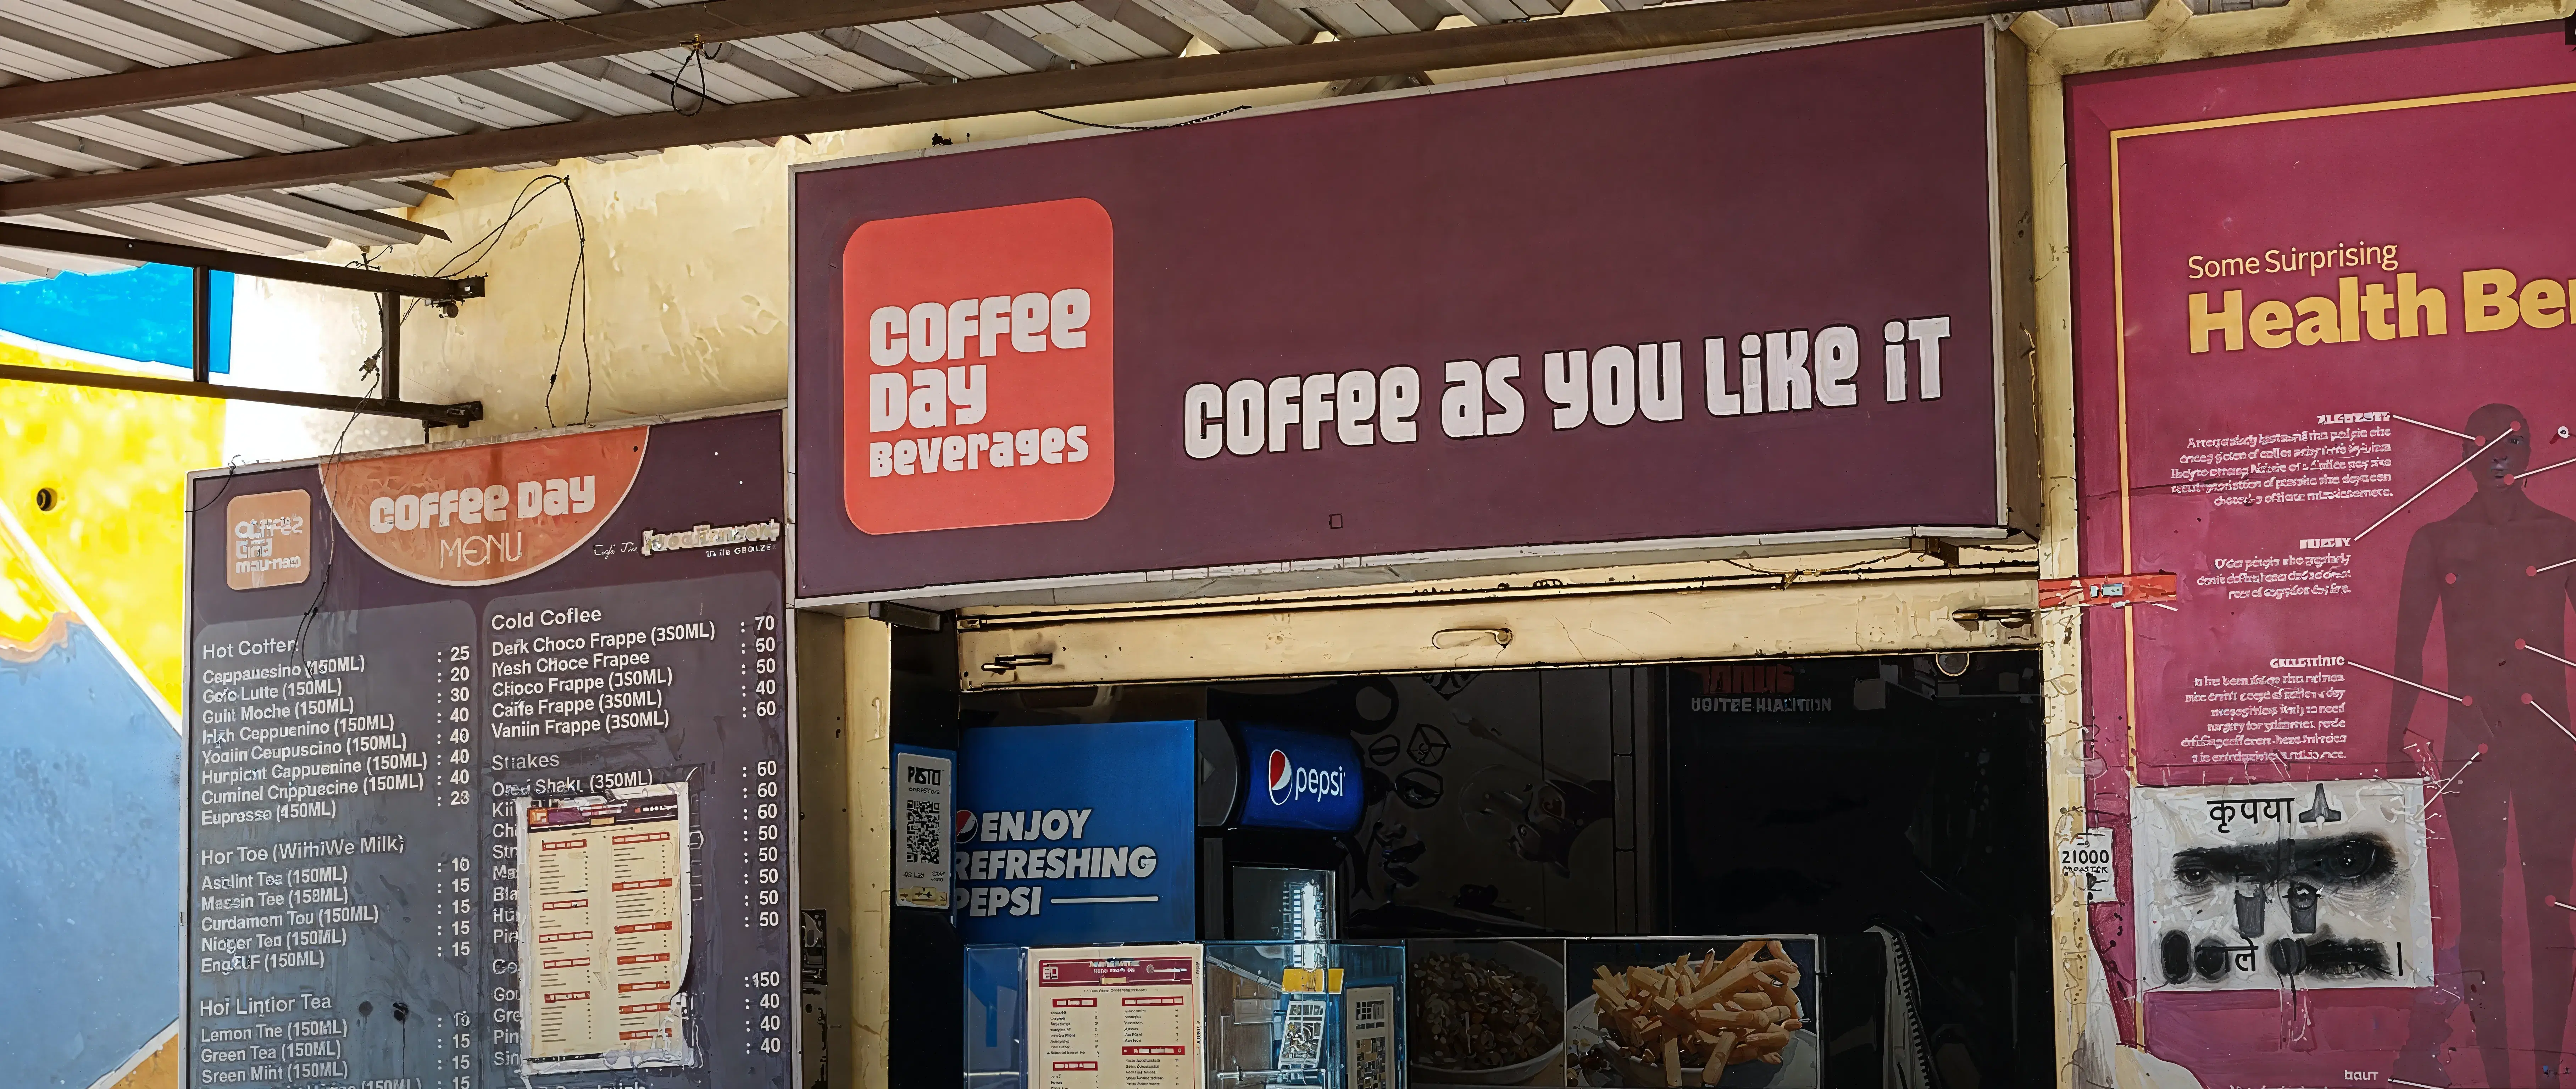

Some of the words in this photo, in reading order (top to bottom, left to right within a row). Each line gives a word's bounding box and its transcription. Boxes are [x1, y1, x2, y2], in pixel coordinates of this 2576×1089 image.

[2188, 253, 2260, 279] Some
[2188, 272, 2447, 353] Health
[2463, 269, 2576, 333] Be
[492, 612, 533, 630] Cold
[590, 632, 646, 649] Frappe
[755, 615, 775, 631] 70
[203, 644, 233, 659] Hot
[451, 646, 469, 661] 25
[593, 653, 649, 670] Frapee
[756, 637, 775, 653] 50
[451, 666, 469, 681] 20
[549, 677, 604, 694] Frappe
[756, 658, 776, 674] 50
[450, 687, 469, 702] 30
[539, 698, 594, 716] Frappe
[756, 680, 776, 695] 40
[450, 708, 469, 722] 40
[545, 719, 601, 736] Frappe
[757, 701, 776, 716] 60
[450, 749, 469, 764] 40
[757, 760, 777, 776] 60
[450, 769, 469, 784] 40
[1295, 766, 1343, 802] pepsi
[757, 782, 777, 798] 60
[757, 803, 777, 819] 60
[2207, 798, 2295, 833] कृपया
[759, 825, 778, 841] 50
[980, 809, 1092, 842] ENJOY
[759, 847, 778, 862] 50
[2062, 849, 2109, 864] 21000
[452, 857, 470, 871] 10
[956, 847, 1156, 879] REFRESHING
[759, 869, 778, 883] 50
[452, 878, 470, 893] 15
[760, 890, 779, 905] 50
[956, 887, 1042, 916] PEPSI
[452, 899, 470, 914] 15
[760, 911, 779, 927] 50
[452, 921, 470, 936] 15
[452, 942, 470, 956] 15
[301, 993, 332, 1010] Tea
[760, 993, 779, 1009] 40
[760, 1015, 780, 1032] 40
[201, 1028, 251, 1042] Lemon
[201, 1048, 245, 1062] Green
[250, 1046, 276, 1060] Tea
[453, 1034, 470, 1048] 15
[760, 1037, 780, 1053] 40
[202, 1069, 245, 1083] Sreen
[453, 1055, 470, 1069] 15
[453, 1076, 470, 1089] 15
